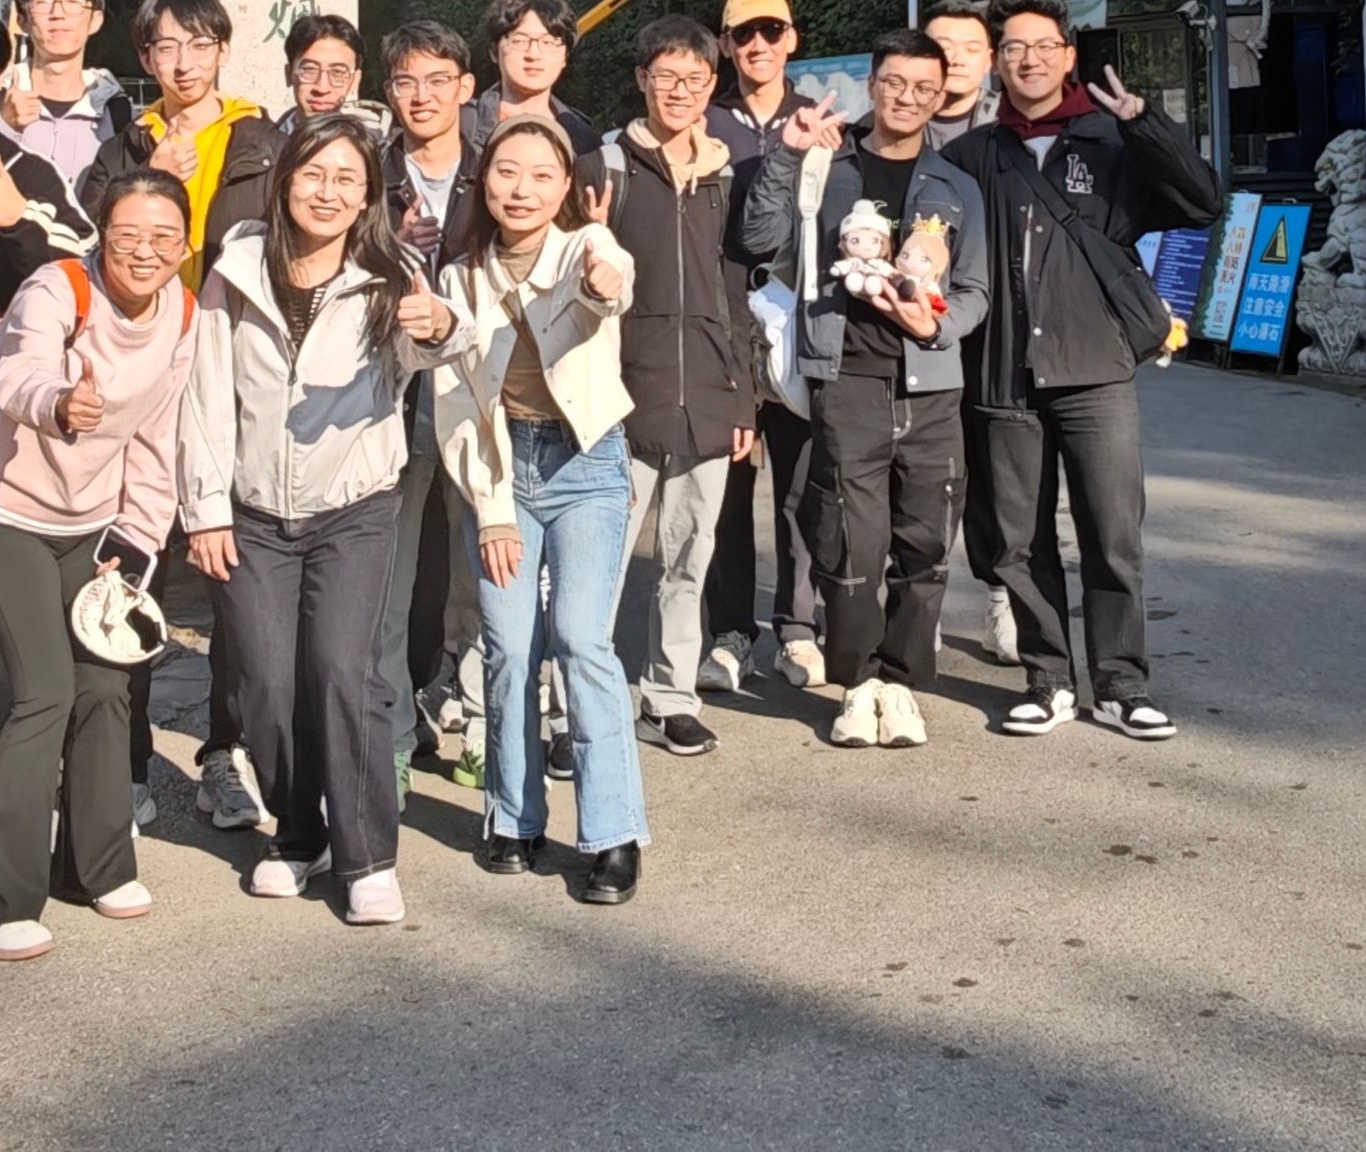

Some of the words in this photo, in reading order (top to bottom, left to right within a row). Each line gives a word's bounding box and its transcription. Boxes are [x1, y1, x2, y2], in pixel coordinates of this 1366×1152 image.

[1065, 154, 1094, 194] LA
[1243, 296, 1286, 318] 注意安全
